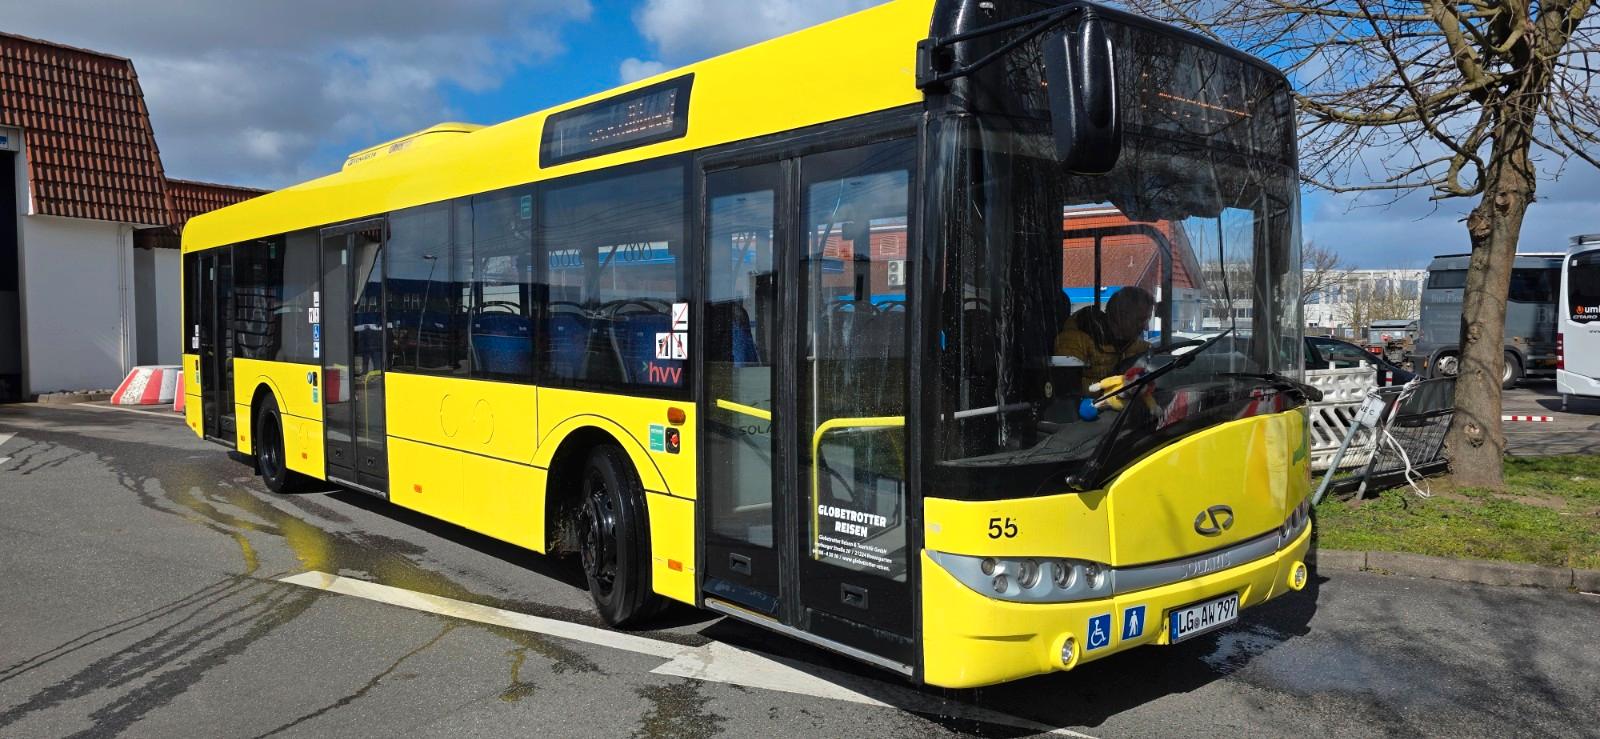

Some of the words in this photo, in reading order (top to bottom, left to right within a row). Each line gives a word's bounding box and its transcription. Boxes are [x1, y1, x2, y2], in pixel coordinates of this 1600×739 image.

[649, 361, 682, 384] hvv
[818, 505, 887, 527] GLOBETROTTER
[835, 521, 867, 537] REISEN
[988, 517, 1018, 539] 55
[1178, 610, 1194, 634] LG
[1200, 606, 1215, 627] AW
[1217, 598, 1237, 622] 797
